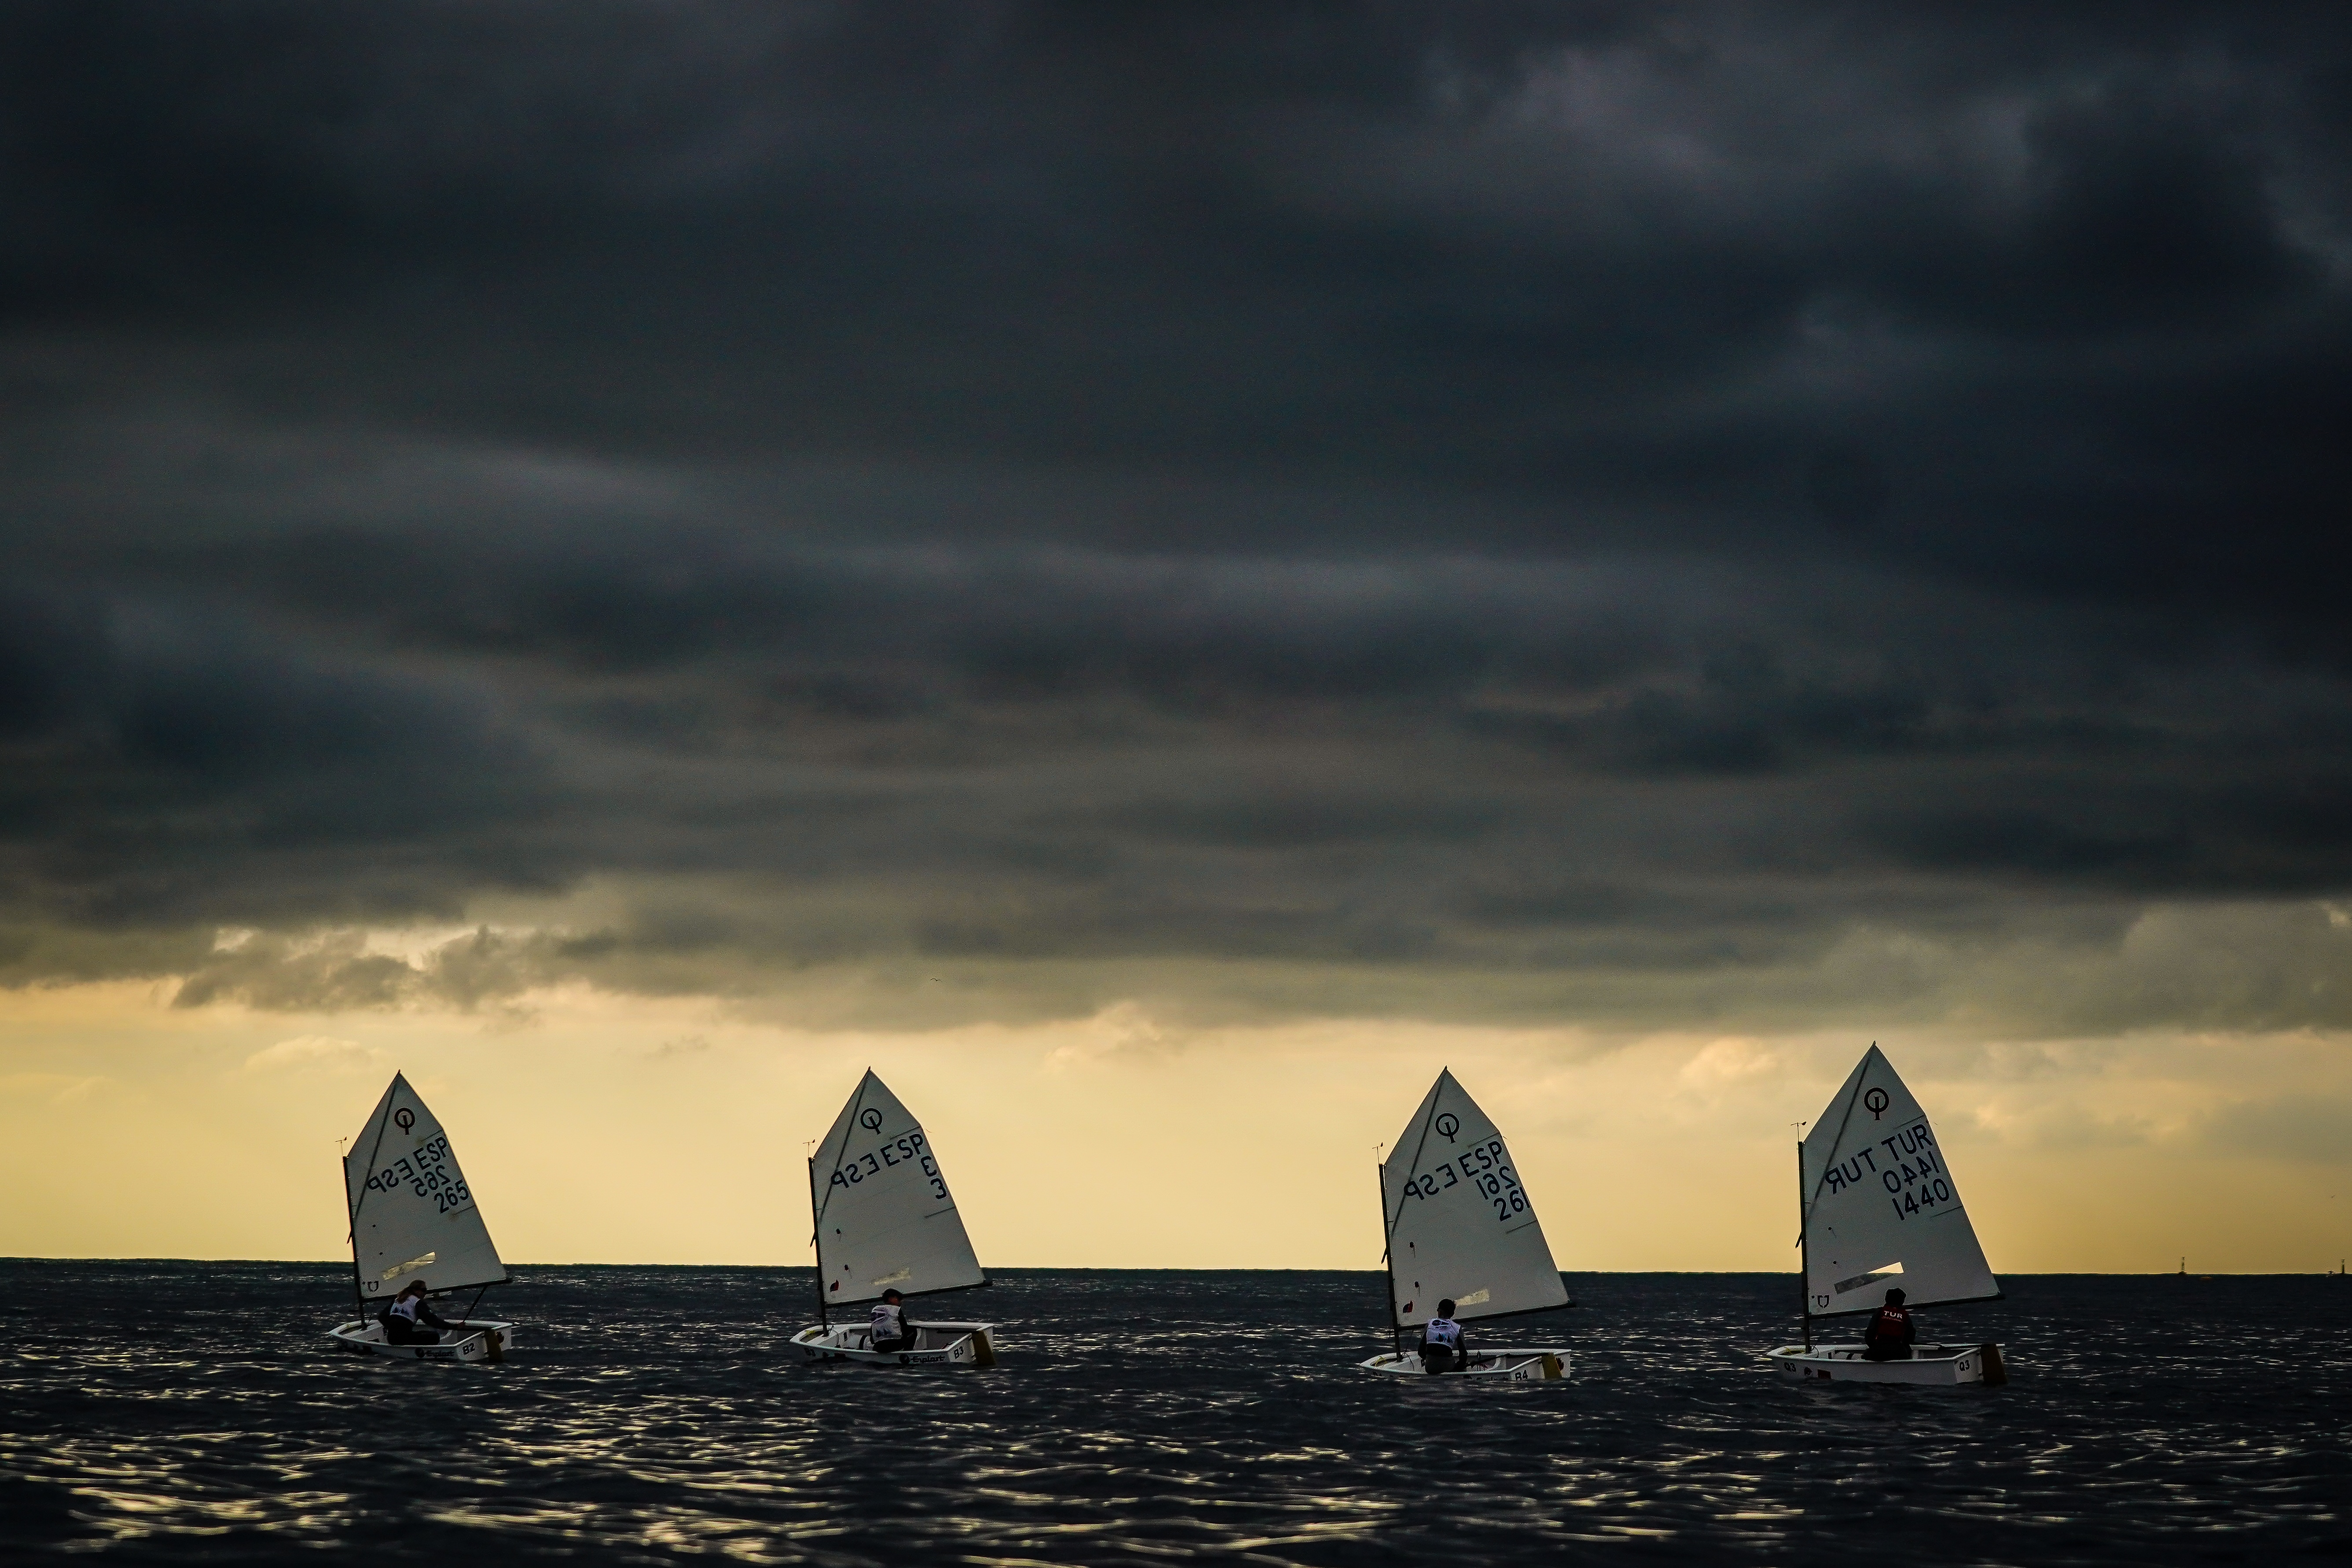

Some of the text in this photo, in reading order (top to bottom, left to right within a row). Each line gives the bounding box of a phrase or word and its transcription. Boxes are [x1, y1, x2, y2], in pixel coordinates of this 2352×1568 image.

[413, 1136, 447, 1170] ESP
[880, 1134, 923, 1167] ESP
[1881, 1124, 1933, 1161] TUR
[1458, 1141, 1502, 1178] ESP
[434, 1179, 469, 1214] 265
[930, 1178, 947, 1199] 3
[1892, 1178, 1949, 1221] 1440
[1493, 1187, 1530, 1221] 261
[1884, 1311, 1903, 1319] TUR
[463, 1343, 475, 1355] B2
[954, 1346, 964, 1359] B3
[1515, 1370, 1528, 1381] B4
[1784, 1362, 1796, 1372] Q3
[1959, 1360, 1970, 1371] Q3
